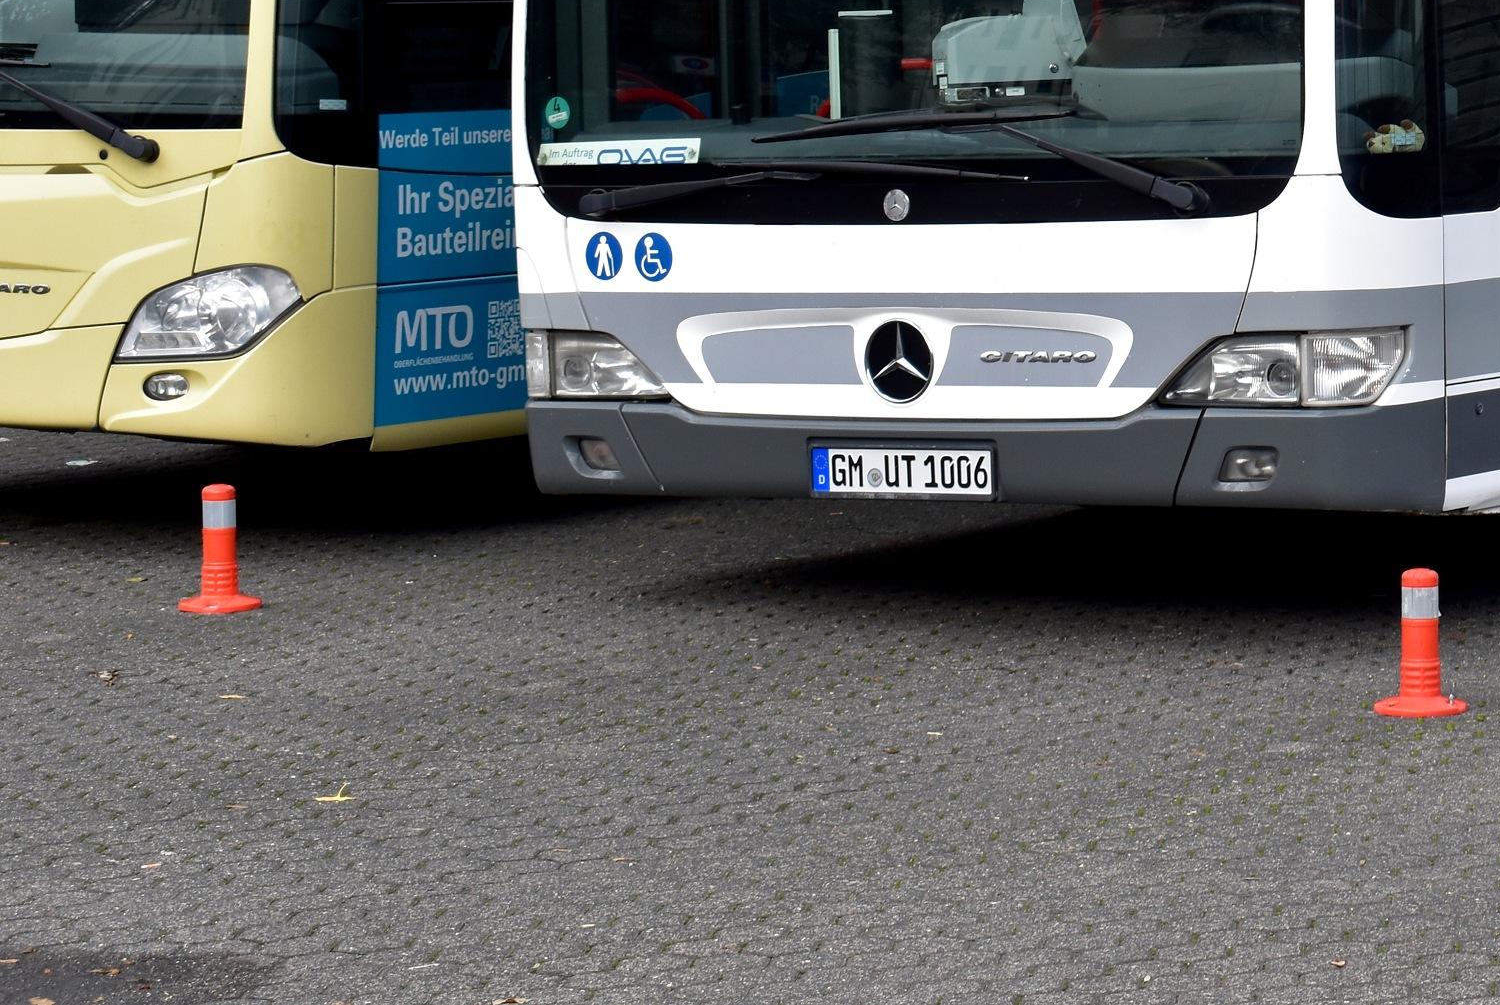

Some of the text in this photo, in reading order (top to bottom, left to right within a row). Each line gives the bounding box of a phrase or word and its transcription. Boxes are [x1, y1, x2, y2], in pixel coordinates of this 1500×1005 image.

[553, 98, 561, 112] 4
[379, 127, 513, 149] Werde Teil unsere
[549, 147, 594, 159] Im Auftrag
[398, 178, 515, 218] Ihr Spezia
[396, 219, 517, 258] Bauteilrei
[0, 283, 51, 295] ARO
[394, 304, 474, 354] MTO
[980, 350, 1097, 364] CITARO
[393, 364, 526, 396] www.mto-gm
[818, 475, 826, 485] D
[831, 454, 988, 489] GM UT 1006
